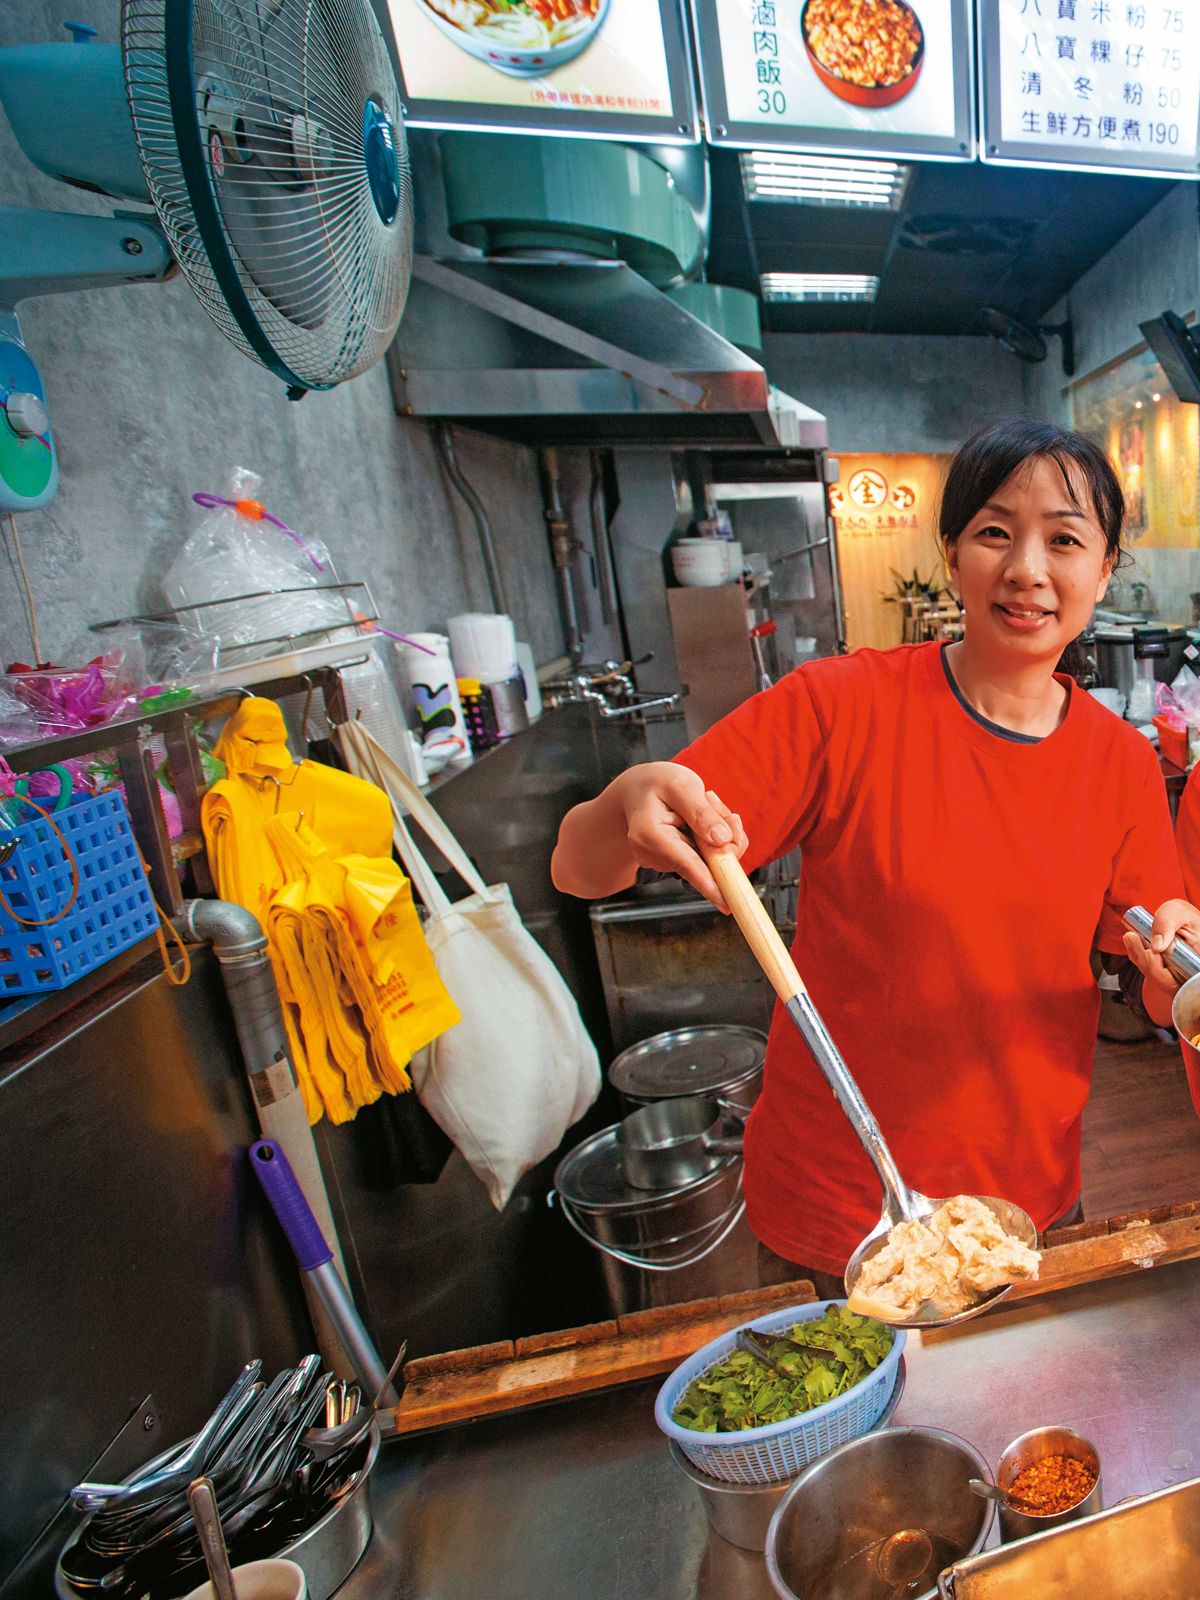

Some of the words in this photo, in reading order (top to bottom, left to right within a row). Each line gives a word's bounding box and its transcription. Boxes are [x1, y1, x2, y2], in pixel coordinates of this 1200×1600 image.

[1021, 0, 1146, 29] 八寶米粉
[1162, 9, 1184, 33] 75
[752, 0, 782, 85] 滷肉飯
[1021, 32, 1145, 67] 八寶粿仔
[1161, 48, 1182, 71] 75
[757, 89, 786, 114] 30
[1021, 71, 1143, 106] 清冬粉
[1158, 87, 1181, 108] 50
[1021, 109, 1142, 142] 生鮮方便煮
[1148, 122, 1179, 145] 190
